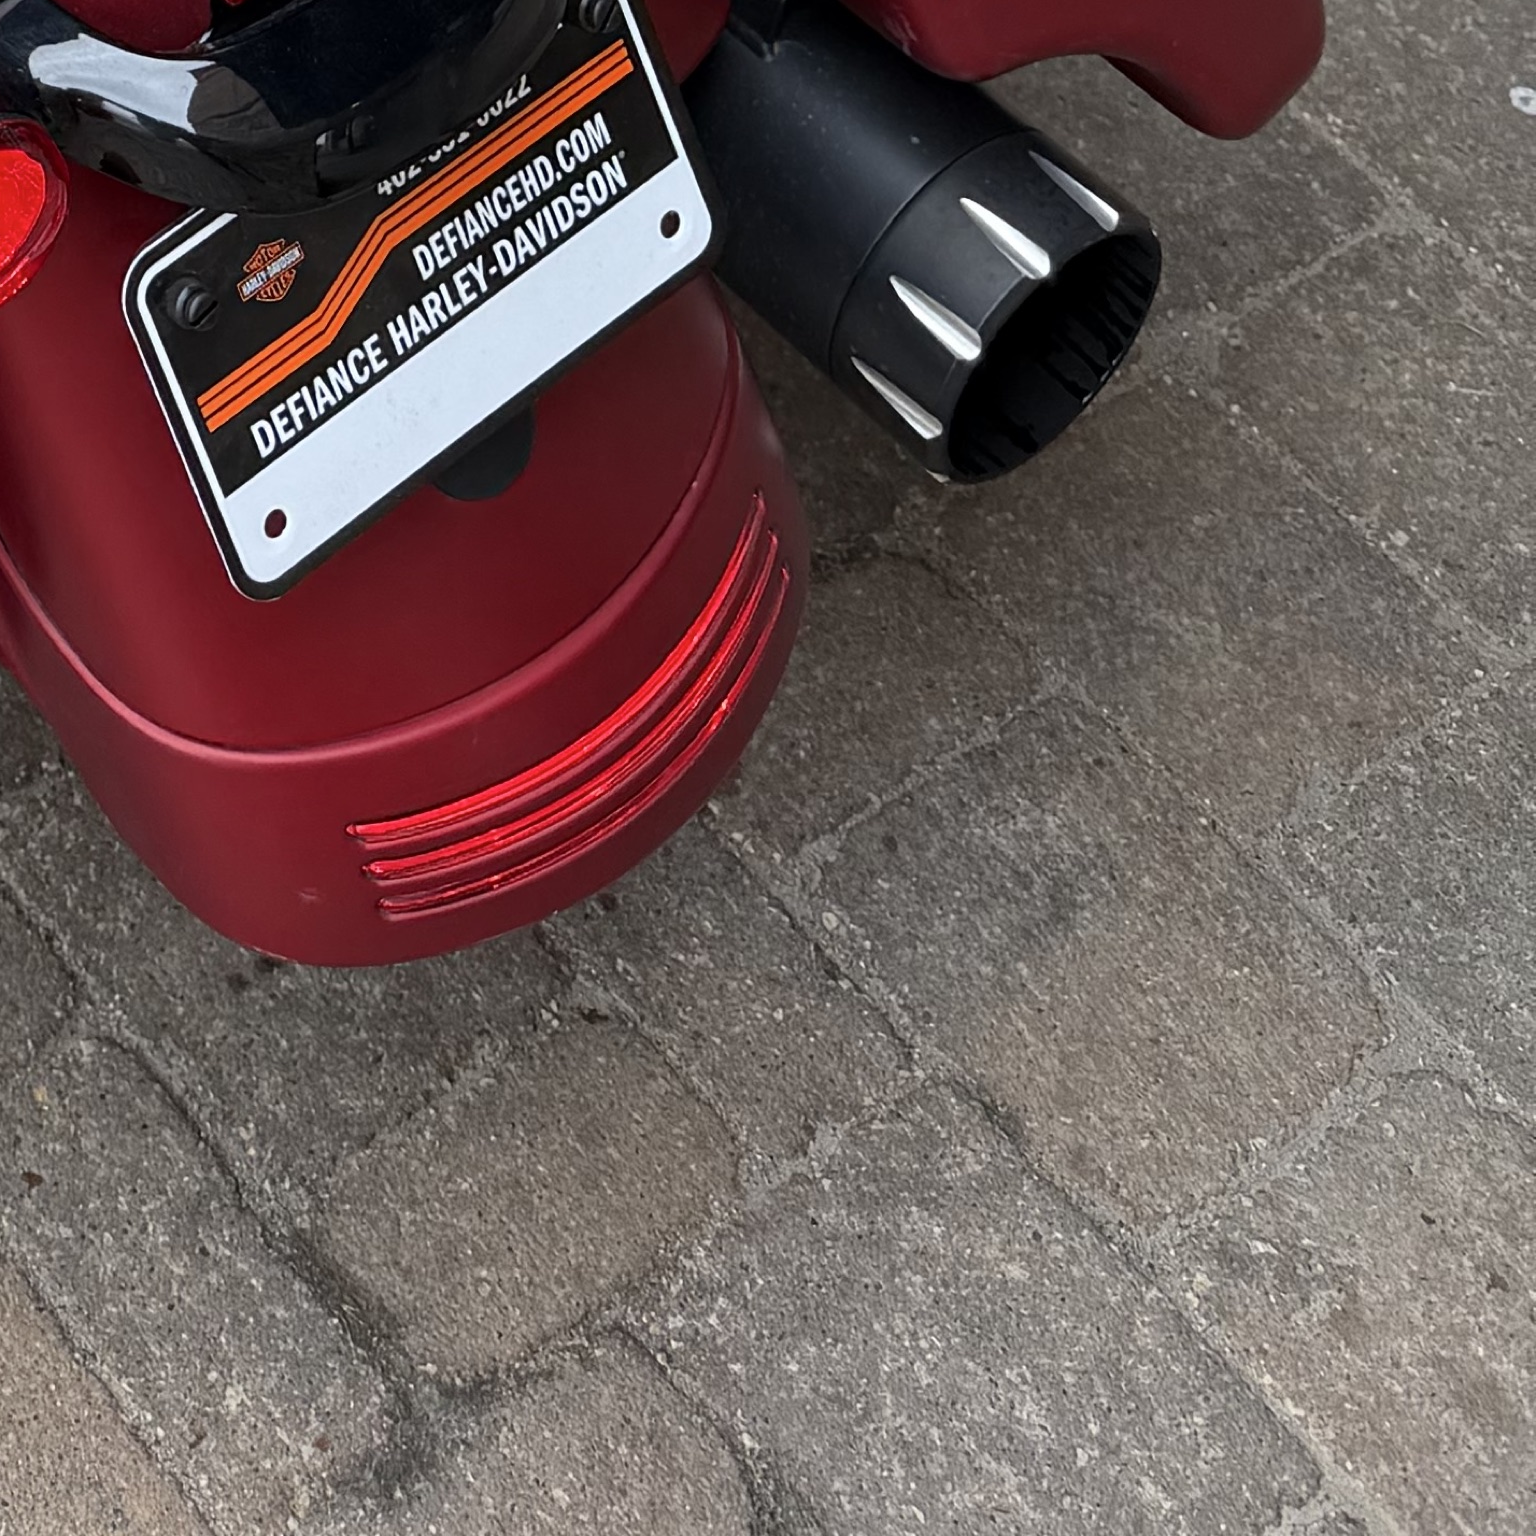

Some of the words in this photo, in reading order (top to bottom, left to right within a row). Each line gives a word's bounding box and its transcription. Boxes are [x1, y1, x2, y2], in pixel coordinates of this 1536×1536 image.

[249, 333, 389, 459] DEFIANCE
[386, 152, 628, 356] HARLEY-DAVIDSON
[412, 111, 612, 282] DEFIANCEHD.COM
